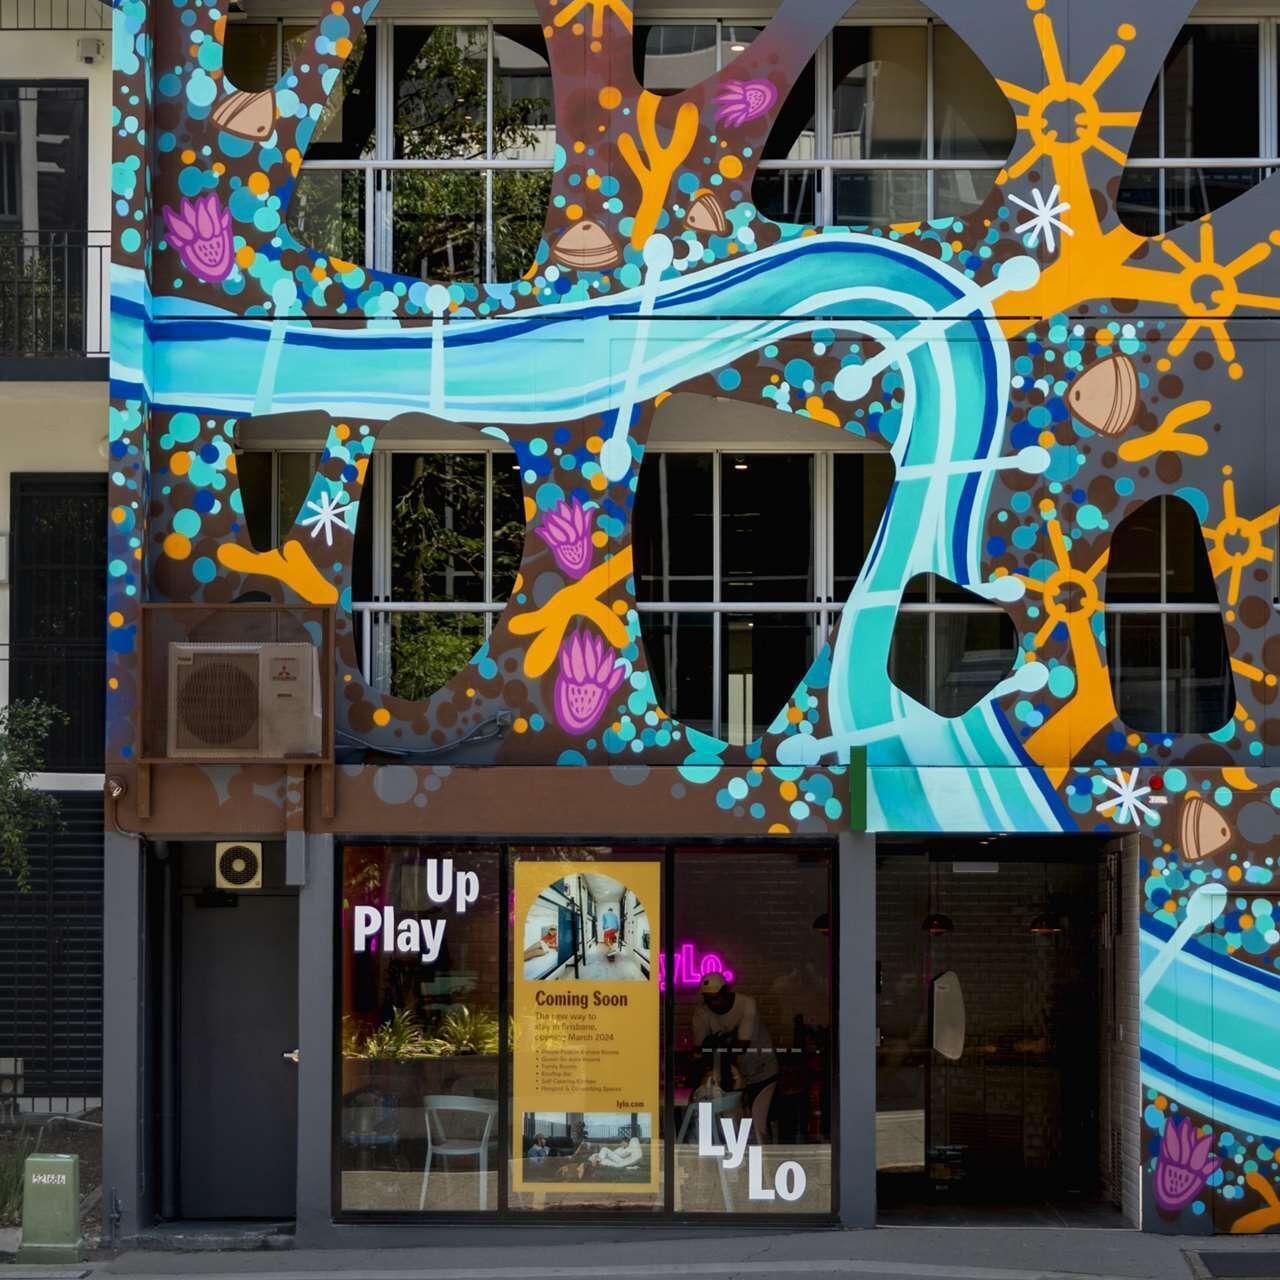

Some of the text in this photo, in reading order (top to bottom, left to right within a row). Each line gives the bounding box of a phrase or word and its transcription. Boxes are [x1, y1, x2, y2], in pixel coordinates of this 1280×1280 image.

[426, 858, 480, 913] Up
[353, 905, 447, 962] Play
[535, 990, 628, 1009] Coming Soon
[568, 1033, 593, 1041] March
[595, 1033, 615, 1041] 2024
[698, 1102, 753, 1169] Ly
[748, 1145, 807, 1201] Lo
